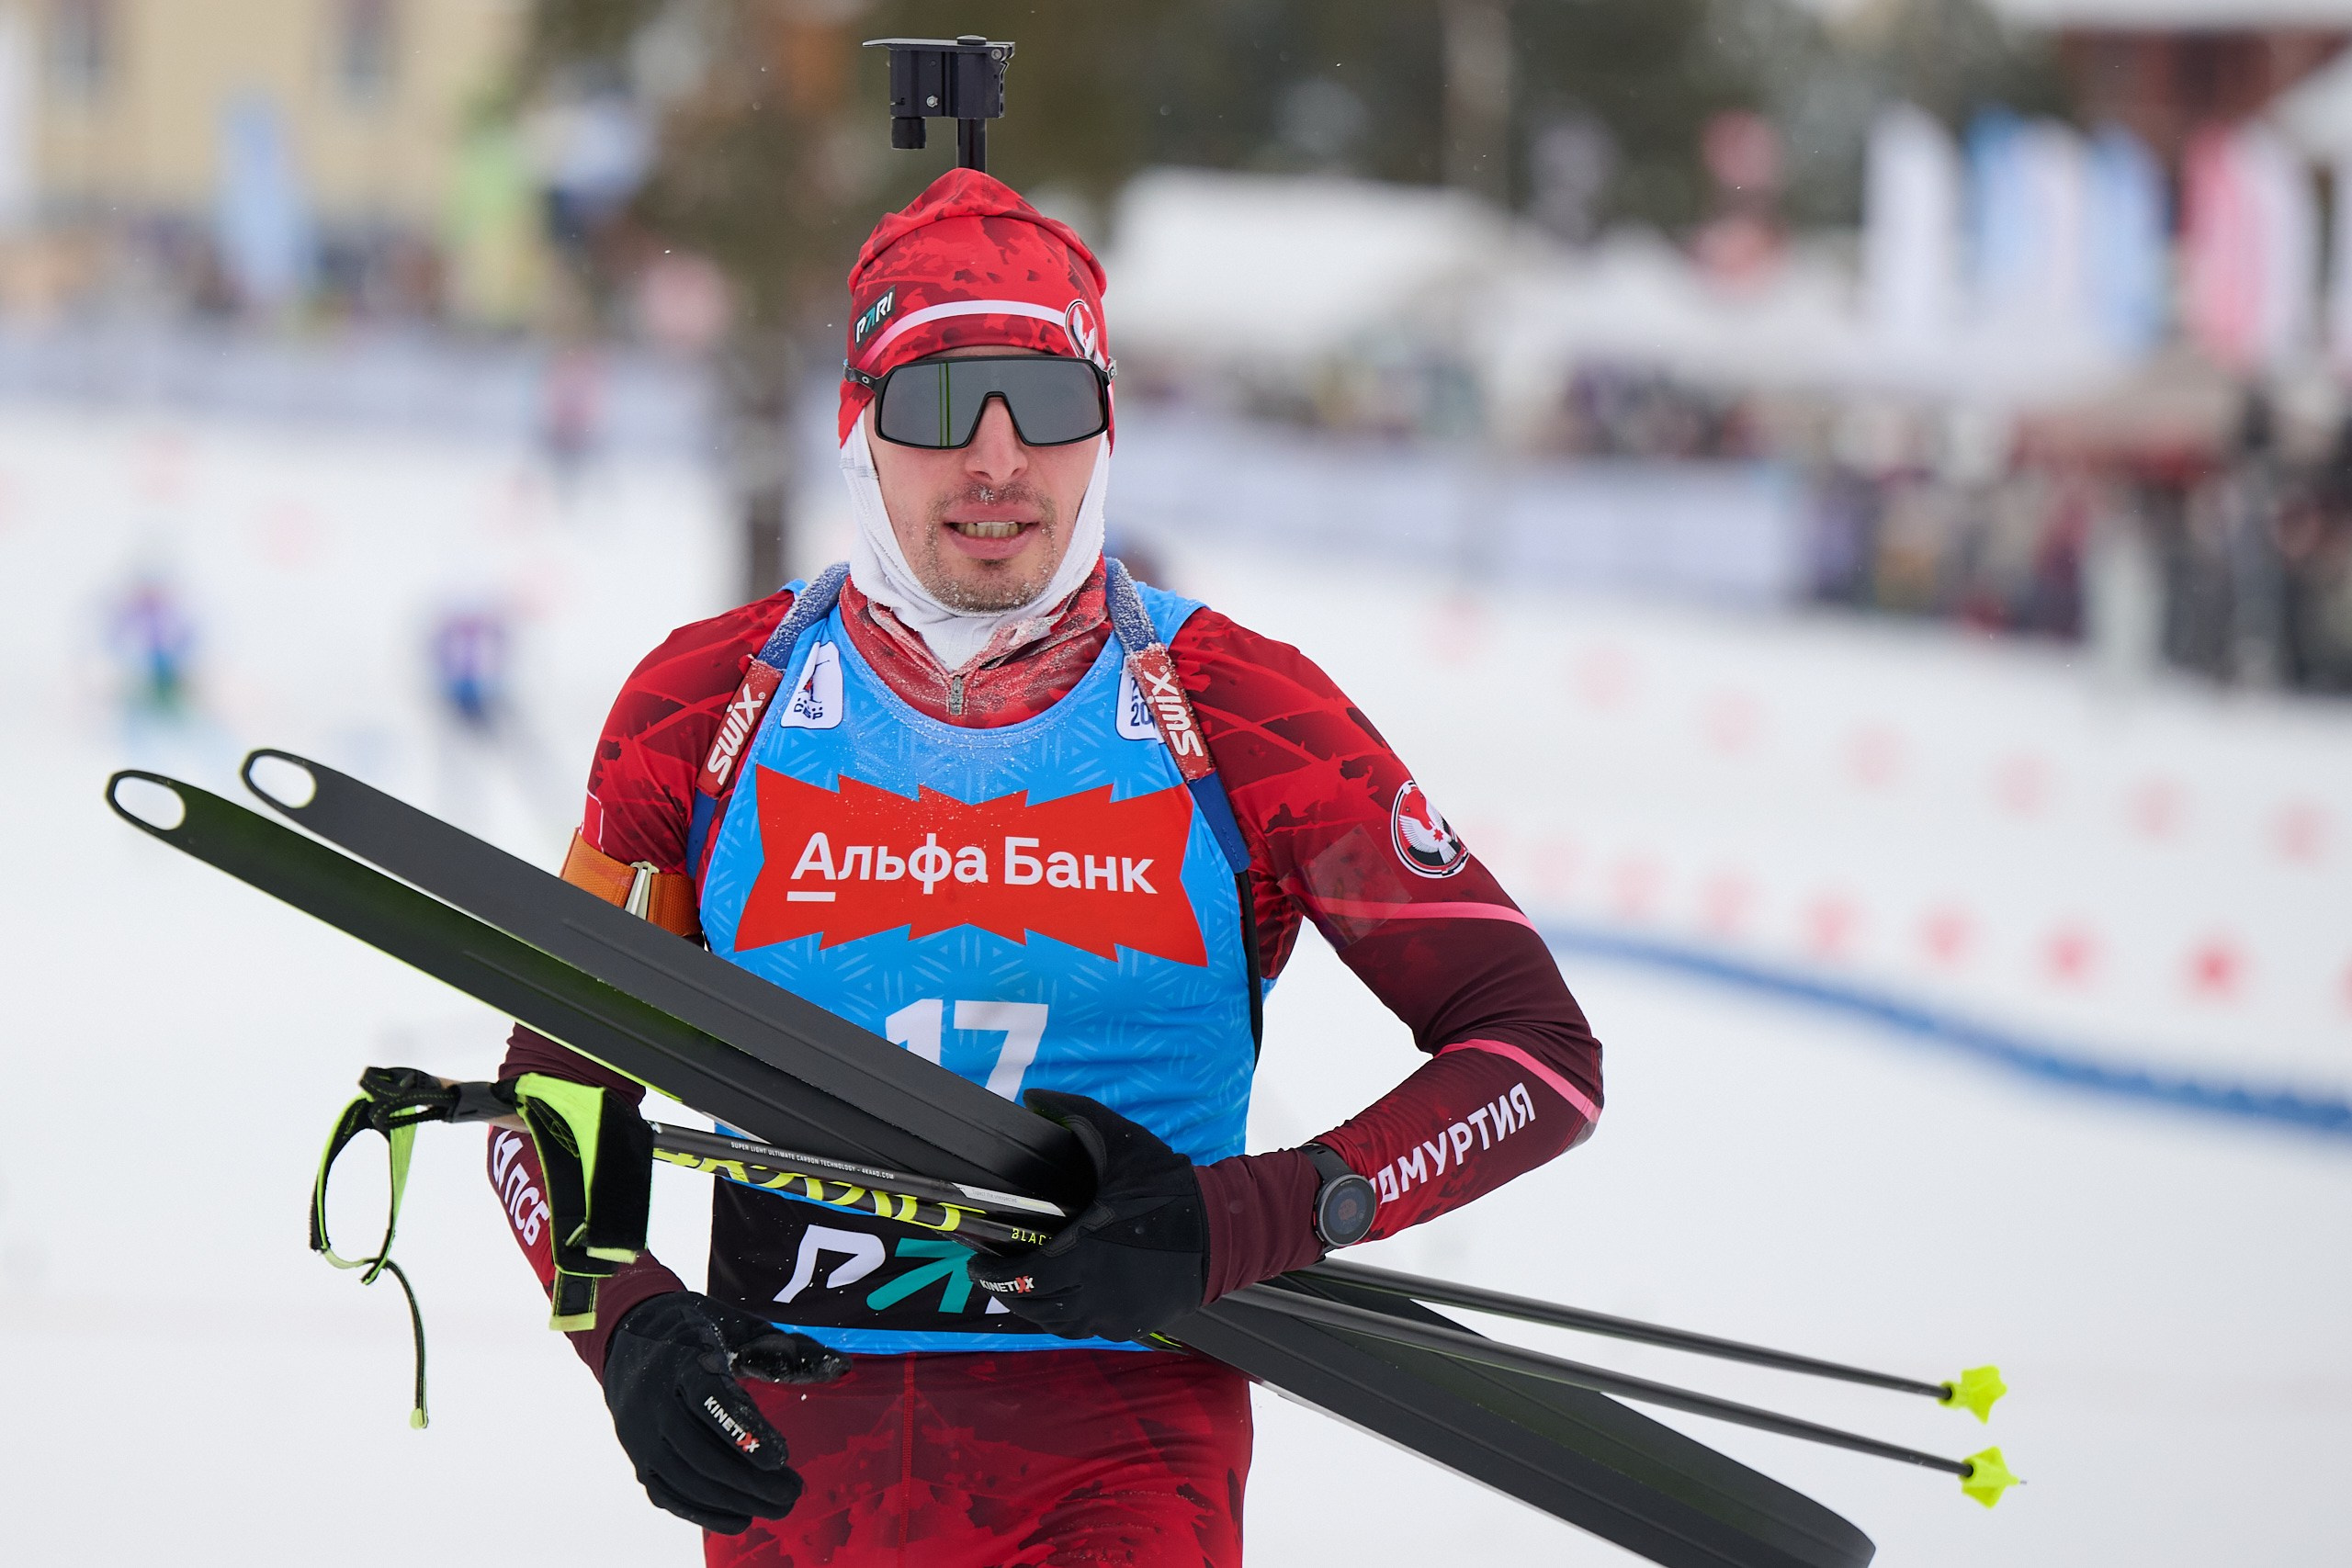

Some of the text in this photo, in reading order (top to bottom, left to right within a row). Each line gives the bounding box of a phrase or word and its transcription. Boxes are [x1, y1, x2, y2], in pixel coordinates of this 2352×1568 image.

[855, 291, 894, 344] PARI
[788, 831, 1159, 897] Альфа Банк
[885, 998, 1049, 1103] 17
[730, 1141, 749, 1151] SUPER
[751, 1145, 767, 1155] LIGHT
[768, 1148, 795, 1160] ULTIMATE
[796, 1155, 820, 1165] CARBON
[820, 1159, 855, 1172] TECHNOLOGY
[1369, 1084, 1537, 1204] ДМУРТИЯ
[503, 1162, 551, 1247] ПСБ
[1011, 1227, 1052, 1246] BLAC
